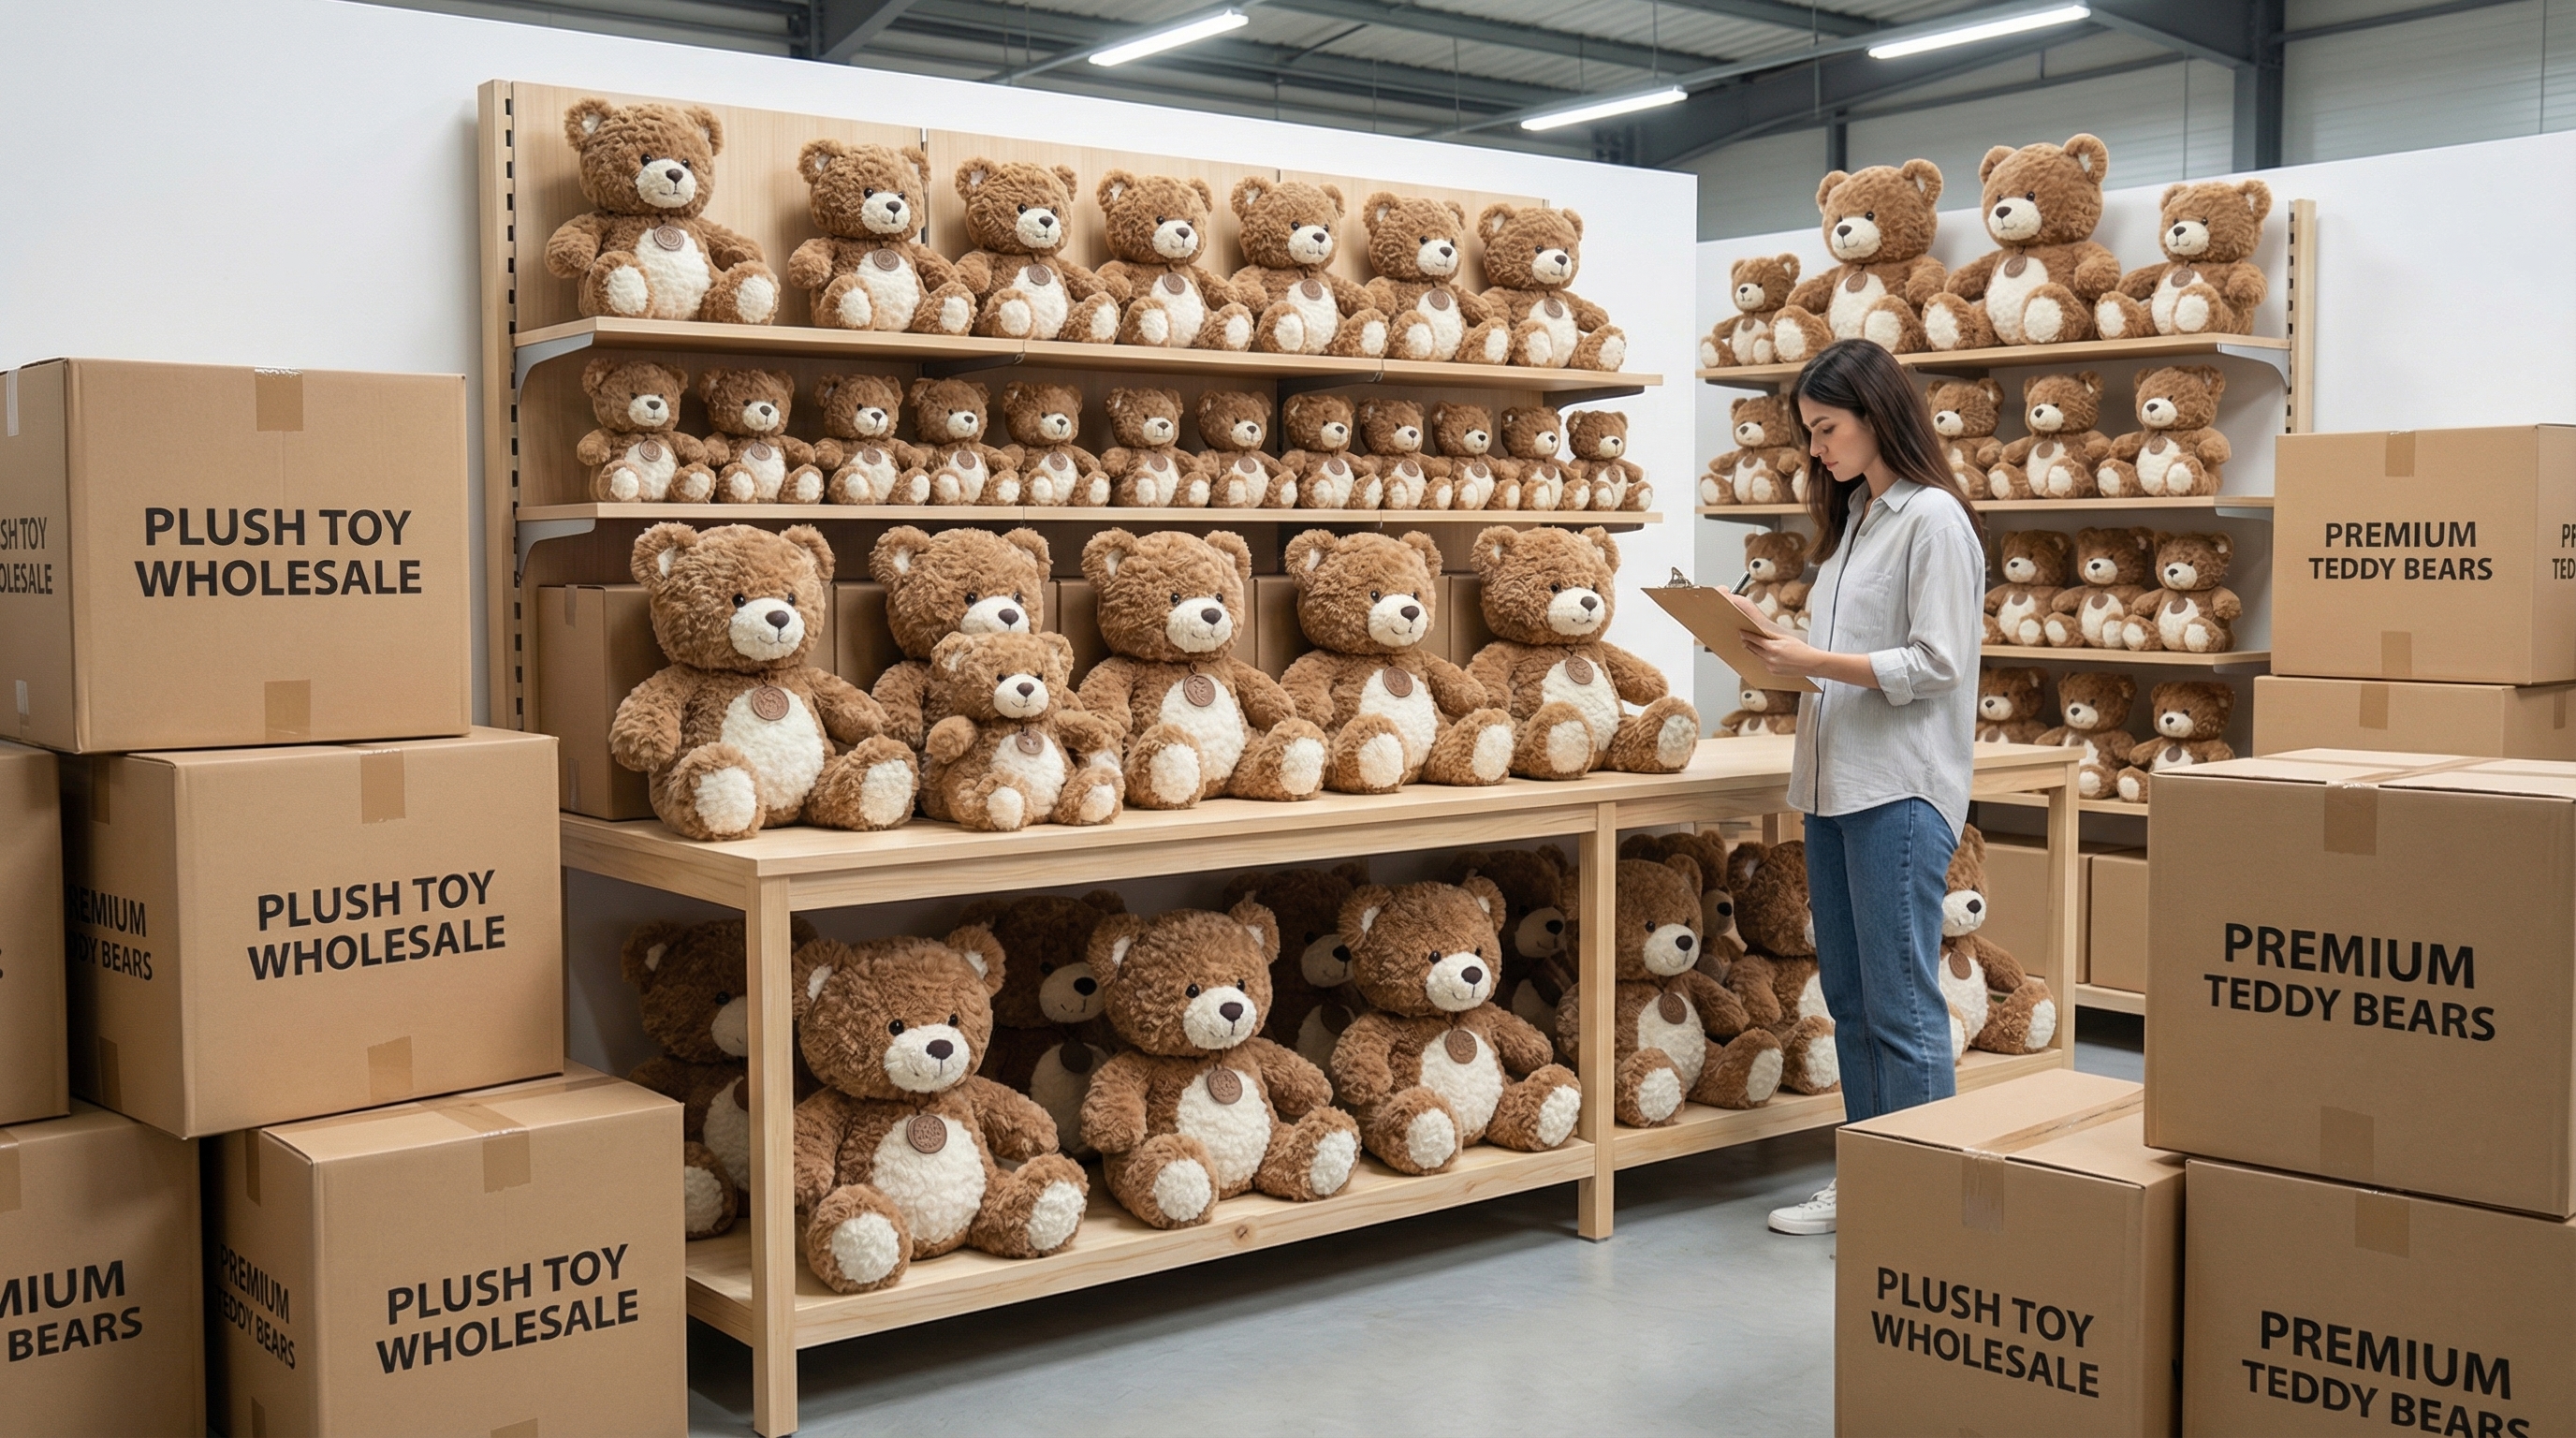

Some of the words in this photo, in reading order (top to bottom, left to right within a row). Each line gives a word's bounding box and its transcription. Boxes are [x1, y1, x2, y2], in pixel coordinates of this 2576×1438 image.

[20, 517, 47, 550] TOY
[145, 506, 306, 547] PLUSH
[318, 508, 413, 547] TOY
[2325, 521, 2477, 549] PREMIUM
[134, 559, 422, 598] WHOLESALE
[2308, 557, 2397, 580] TEDDY
[2404, 557, 2493, 581] BEARS
[257, 880, 402, 932] PLUSH
[412, 869, 496, 913] TOY
[101, 940, 153, 981] BEARS
[247, 914, 506, 981] WHOLESALE
[2224, 922, 2475, 990] PREMIUM
[2203, 973, 2342, 1022] TEDDY
[2353, 991, 2496, 1042] BEARS
[220, 1243, 289, 1325] PREMIUM
[388, 1262, 533, 1326] PLUSH
[542, 1242, 629, 1293] TOY
[1877, 1266, 2000, 1328] PLUSH
[2011, 1297, 2095, 1348] TOY
[8, 1306, 142, 1363] BEARS
[214, 1284, 253, 1336] TEDDY
[256, 1313, 296, 1371] BEARS
[374, 1288, 639, 1375] WHOLESALE
[1870, 1310, 2100, 1399] WHOLESALE
[2261, 1310, 2511, 1401] PREMIUM
[2241, 1358, 2379, 1418] TEDDY
[2391, 1391, 2530, 1438] BEARS
